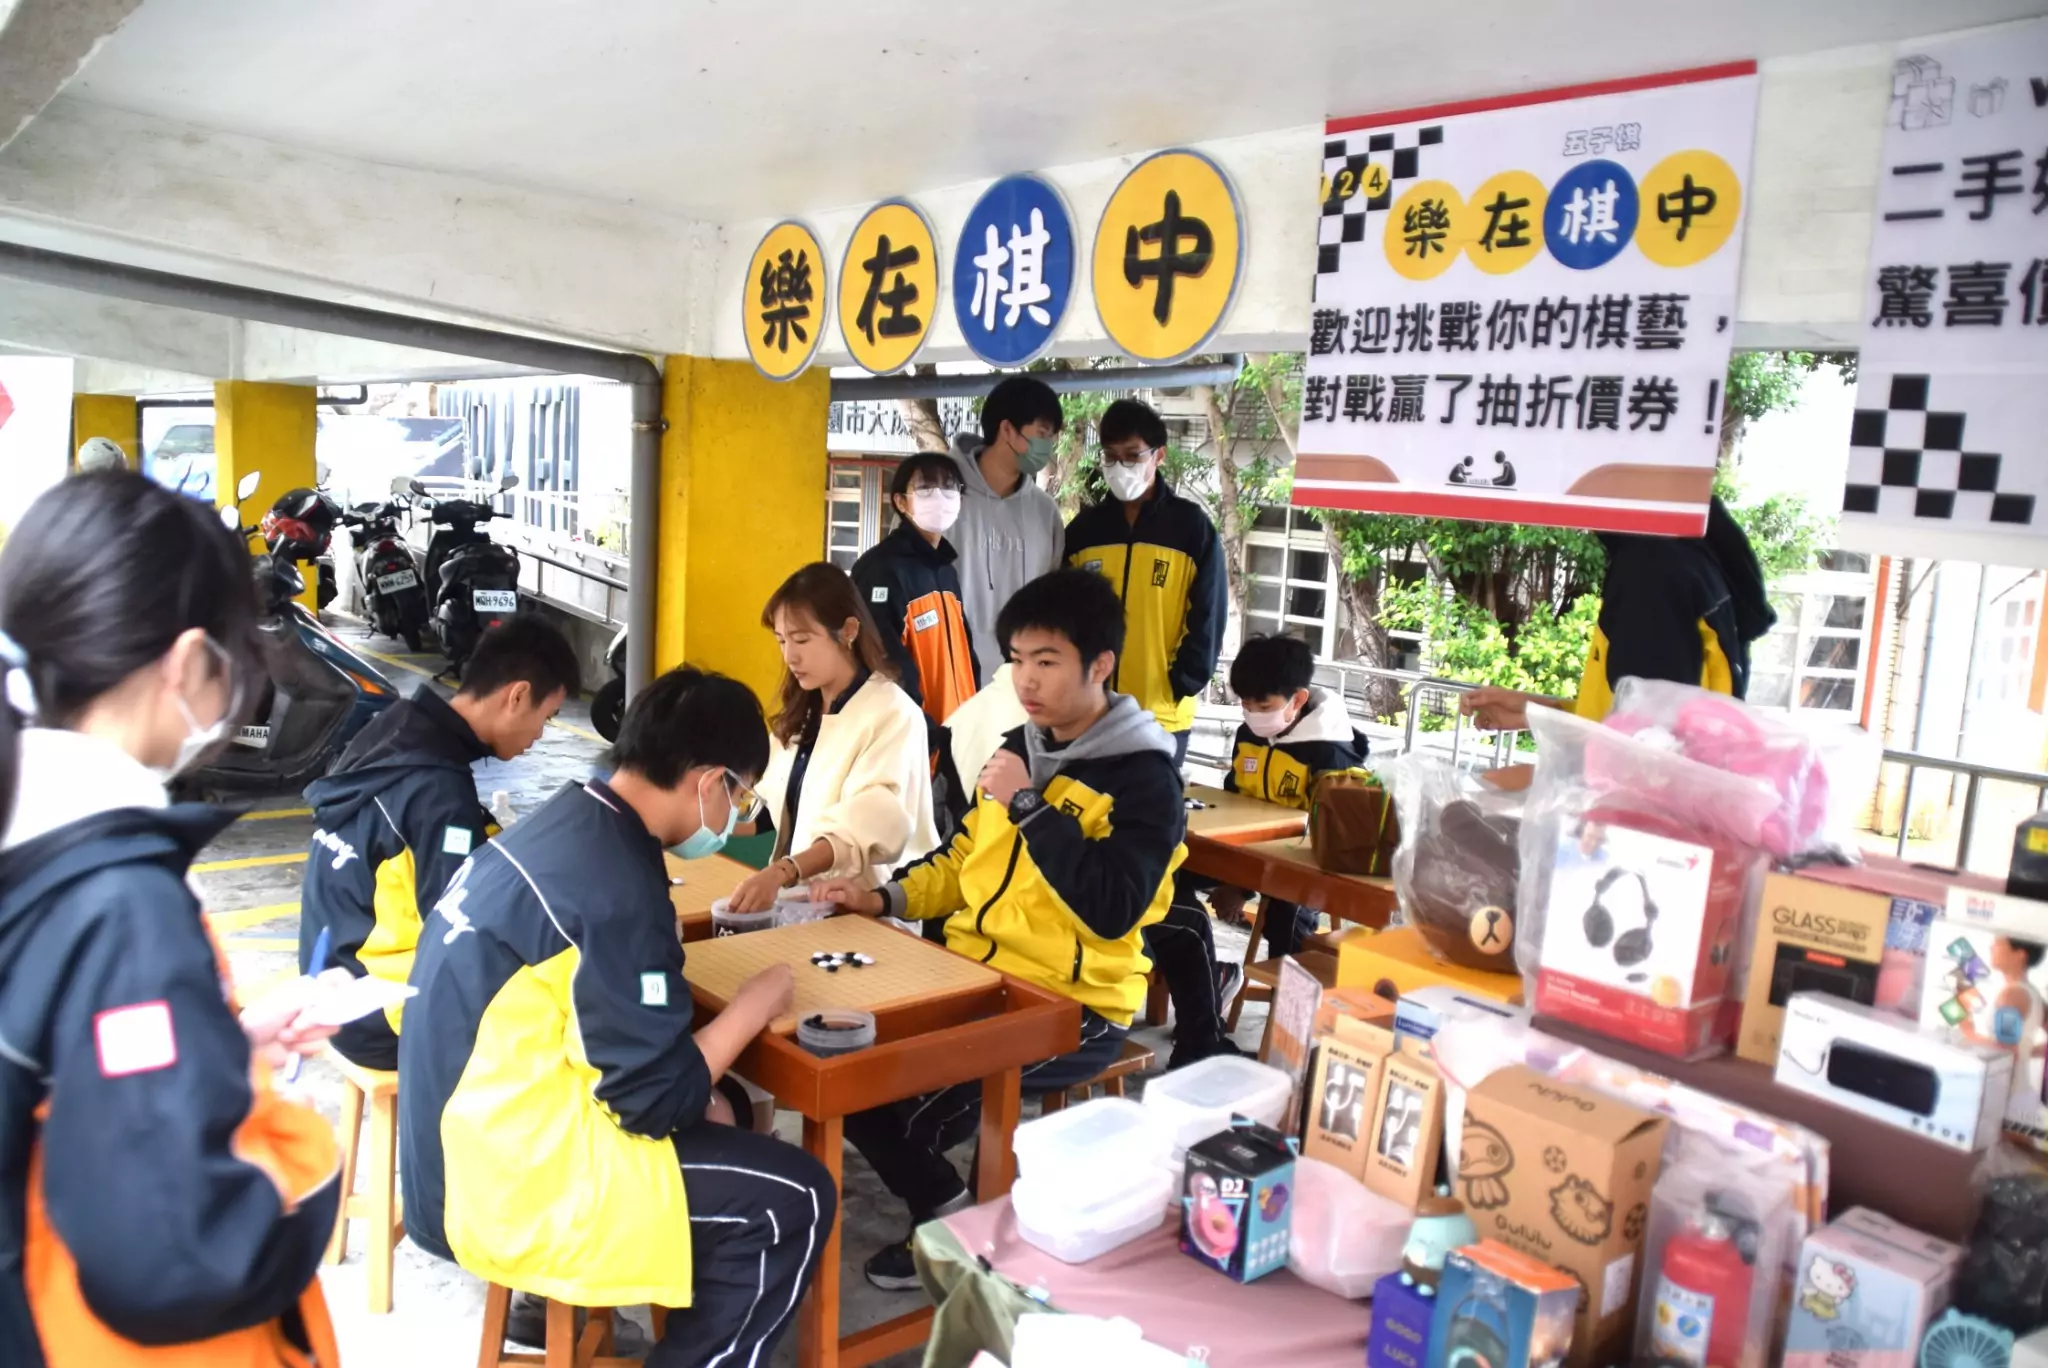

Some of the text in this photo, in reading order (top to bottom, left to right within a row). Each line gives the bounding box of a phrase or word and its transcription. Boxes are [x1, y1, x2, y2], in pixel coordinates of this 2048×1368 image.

[1562, 122, 1642, 157] 五子棋
[1402, 173, 1718, 259] 樂在棋中
[759, 188, 1215, 353] 樂在棋中
[1773, 905, 1836, 935] GLASS
